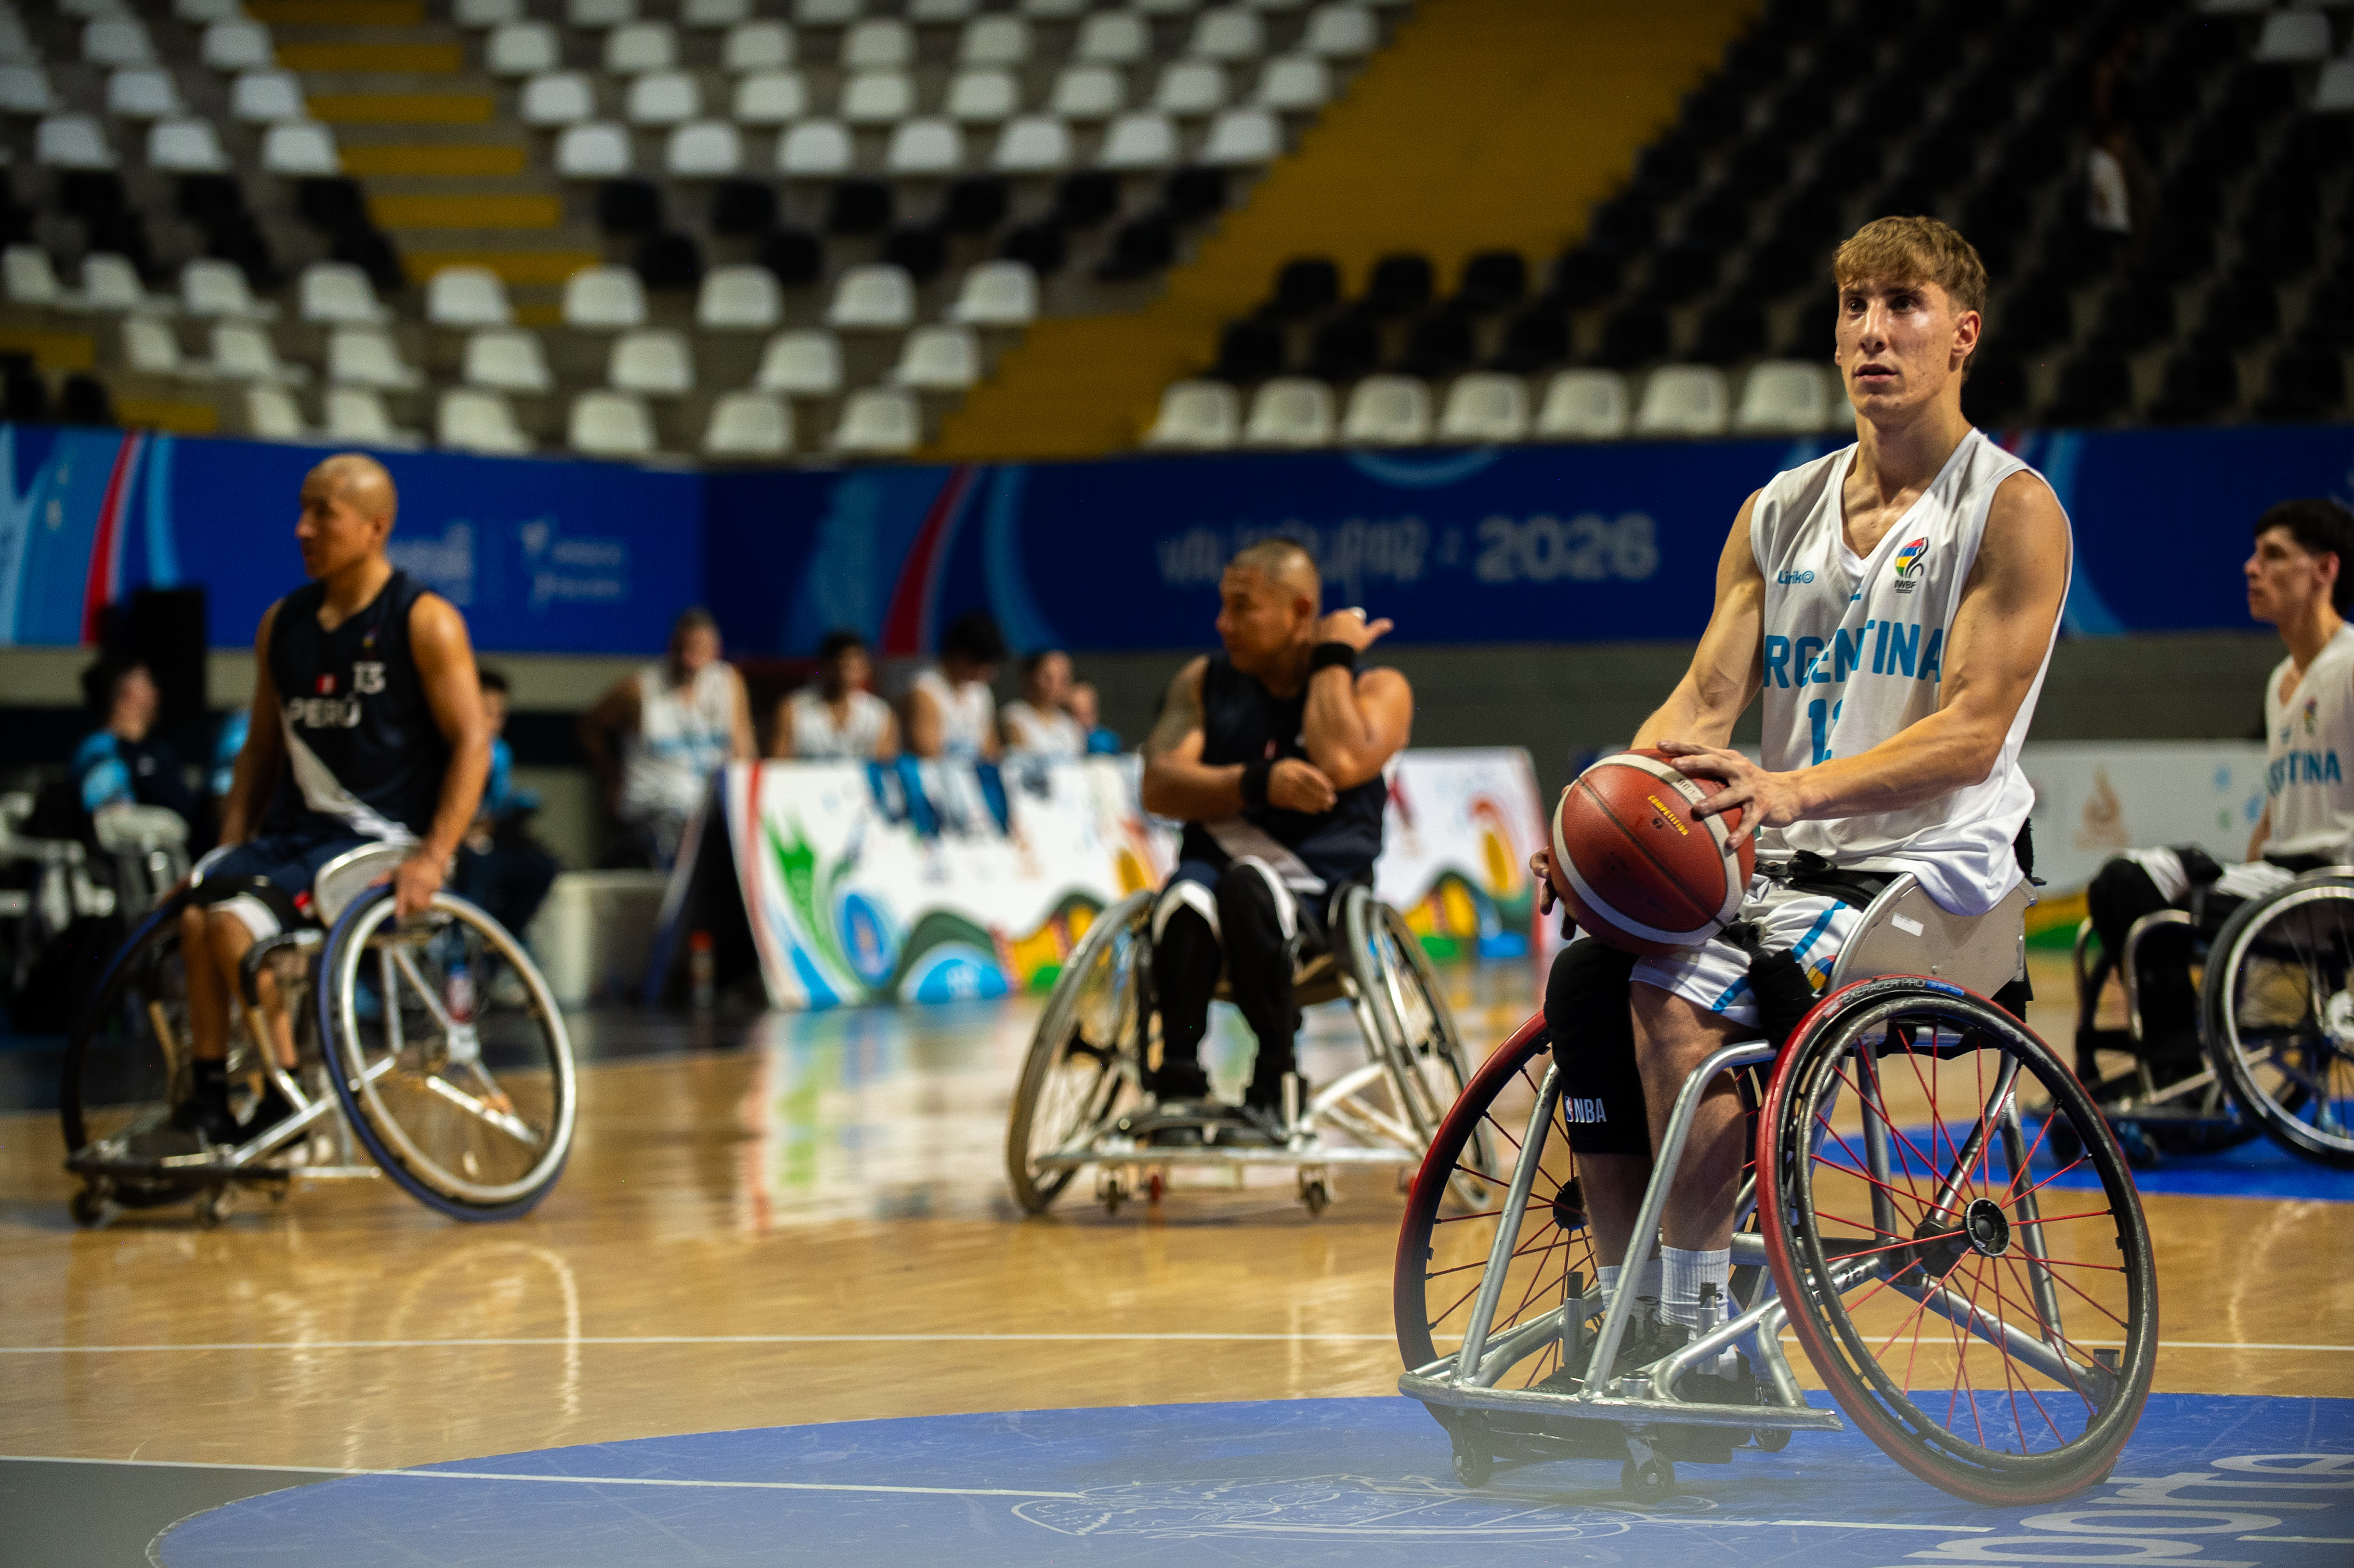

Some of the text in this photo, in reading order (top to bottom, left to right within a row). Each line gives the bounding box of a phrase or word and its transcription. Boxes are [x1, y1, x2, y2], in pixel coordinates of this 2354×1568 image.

[1476, 514, 1657, 581] 2026
[354, 661, 386, 694] 13
[1808, 699, 1843, 766] 1
[1901, 978, 1925, 987] PRO
[1573, 1098, 1607, 1123] NBA
